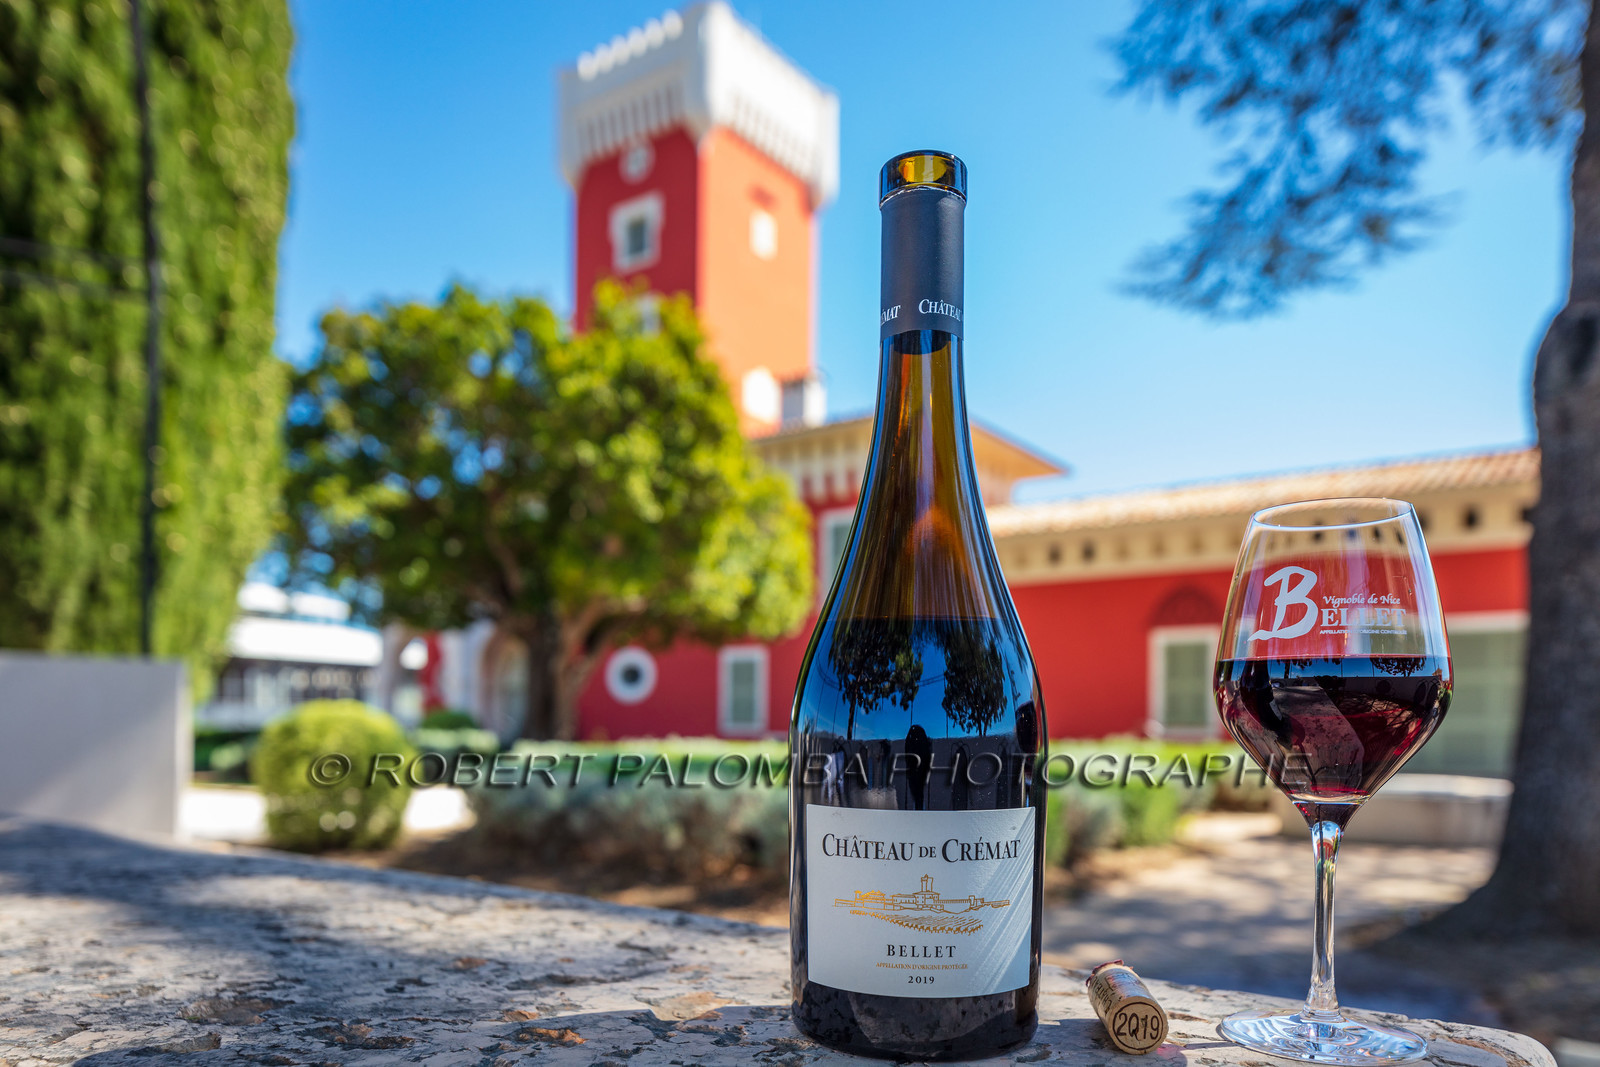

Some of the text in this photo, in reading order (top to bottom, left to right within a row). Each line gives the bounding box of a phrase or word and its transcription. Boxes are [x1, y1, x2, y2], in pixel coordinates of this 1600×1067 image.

[1322, 593, 1401, 608] Vignoble de Nice
[822, 833, 1021, 863] CHÂTEAU DE CRÉMAT
[886, 944, 957, 958] BELLET
[876, 962, 911, 970] APPELLATION
[907, 975, 935, 985] 2019
